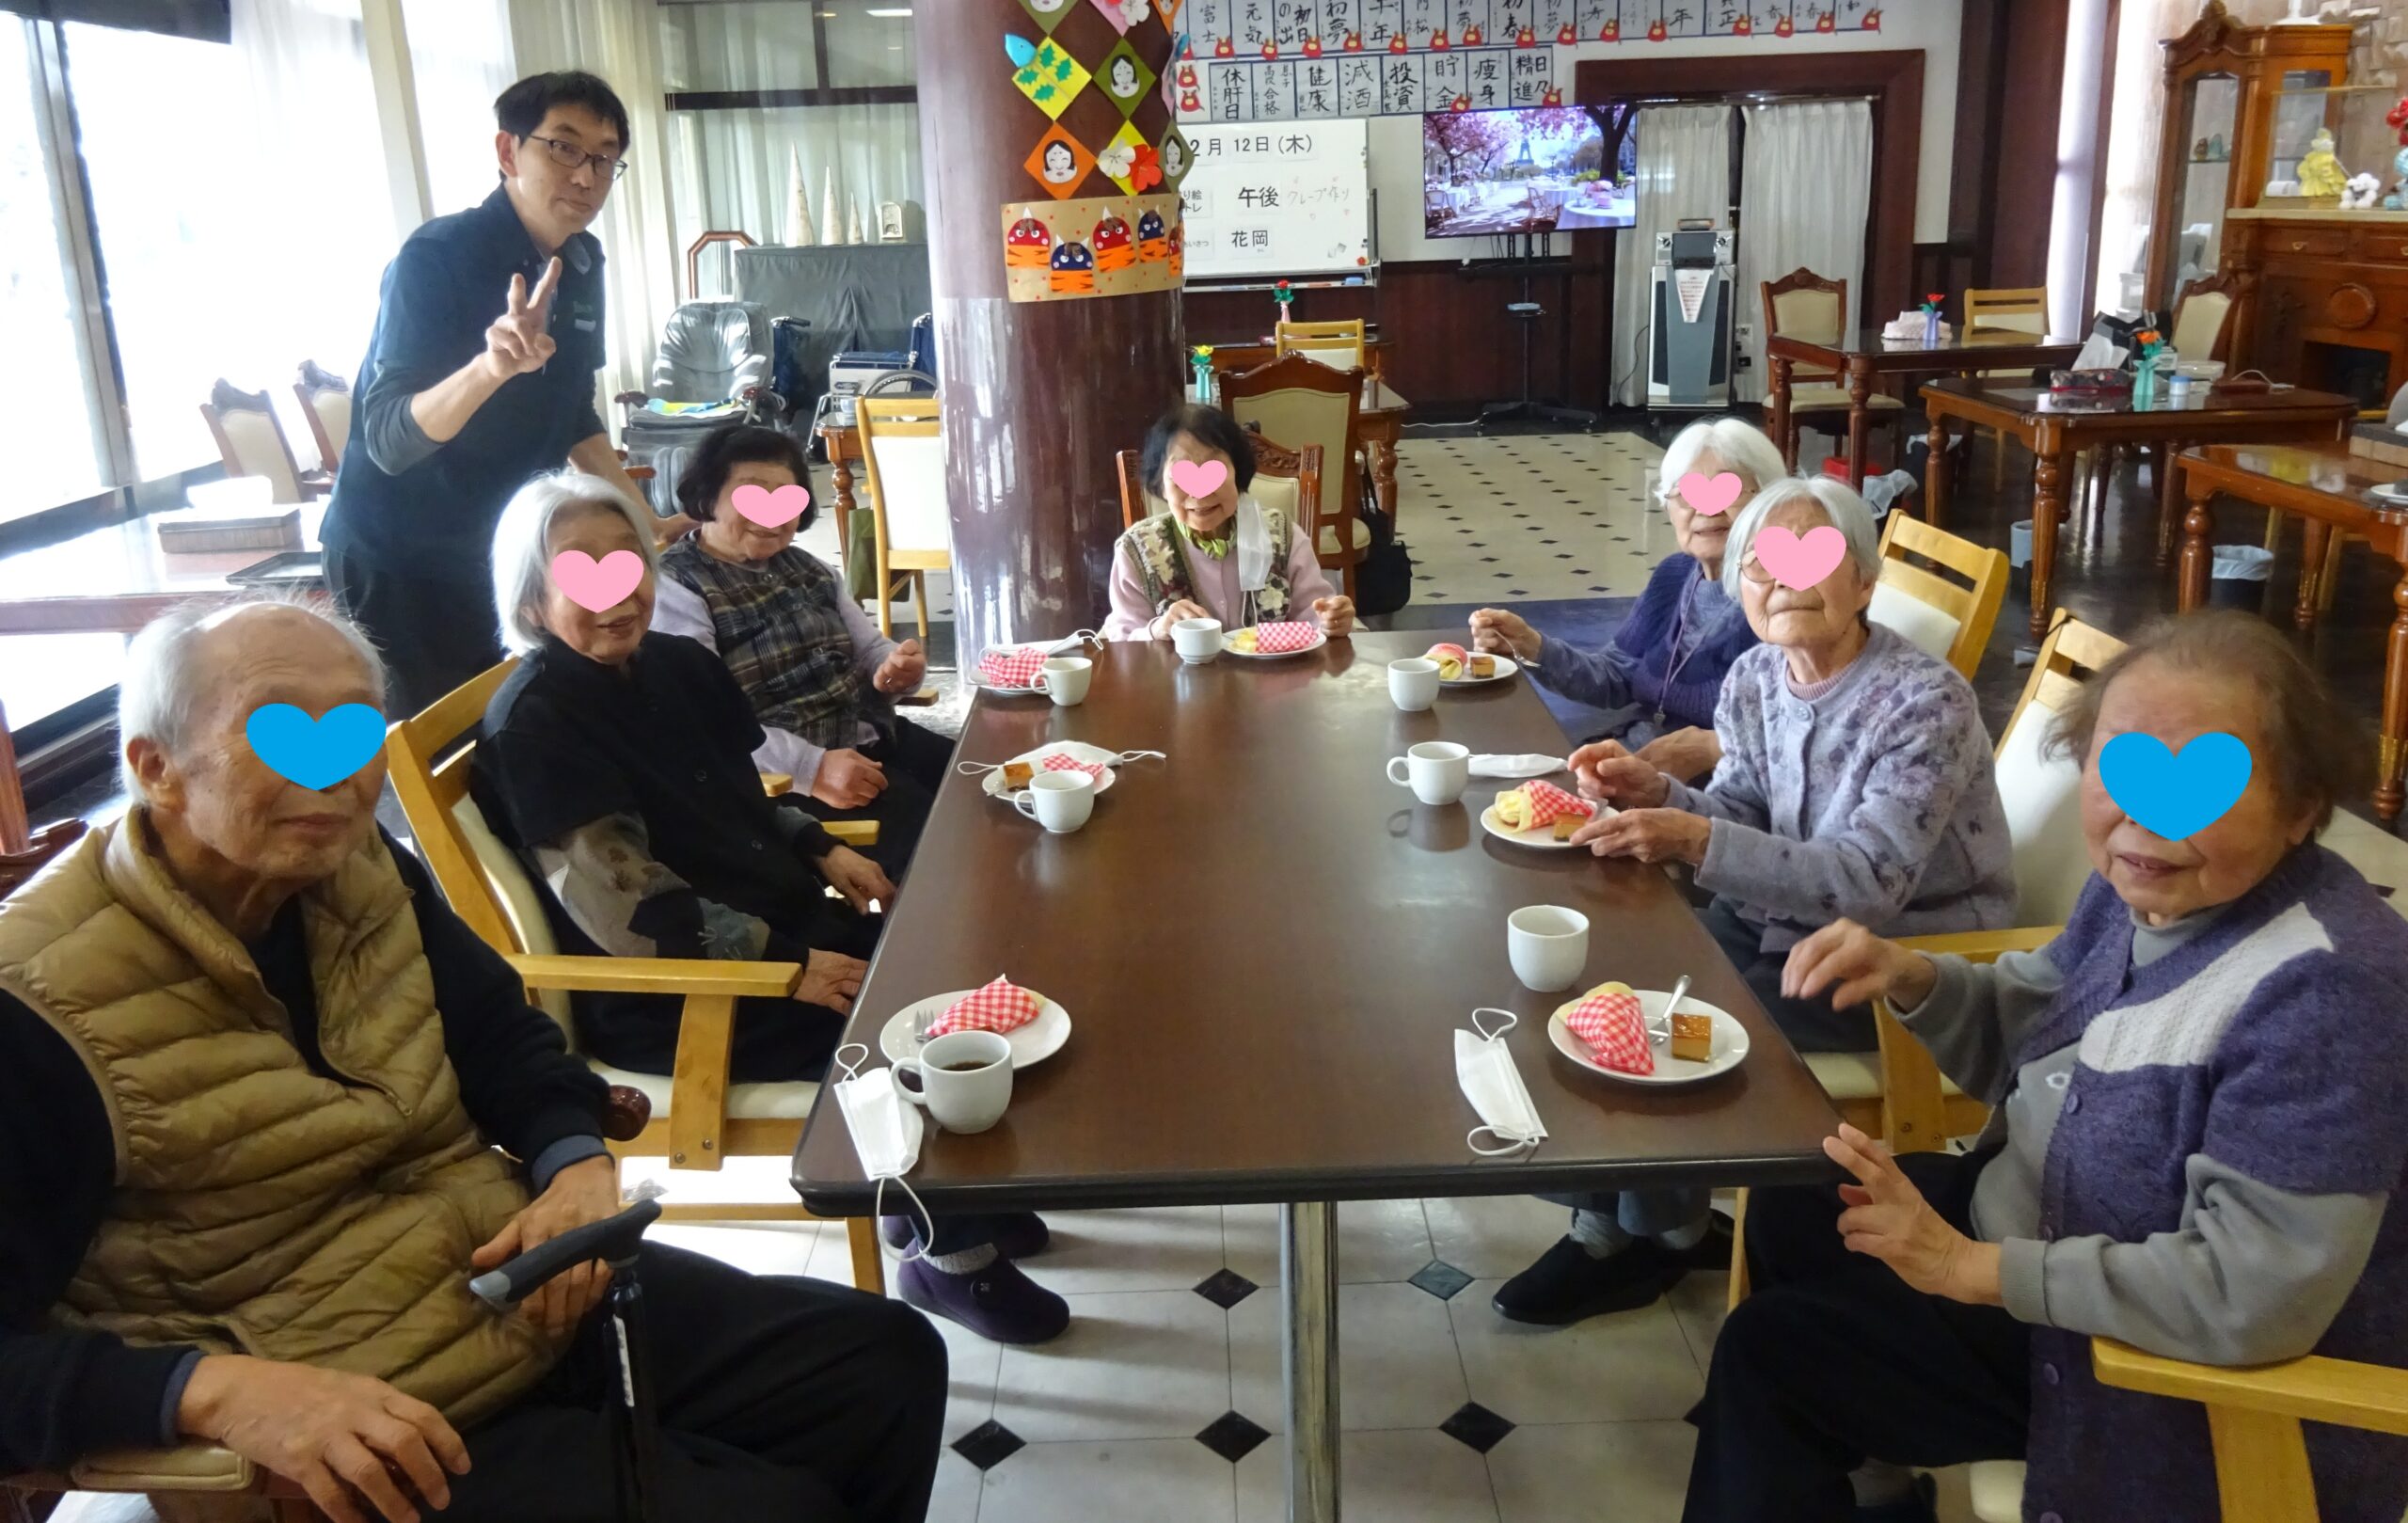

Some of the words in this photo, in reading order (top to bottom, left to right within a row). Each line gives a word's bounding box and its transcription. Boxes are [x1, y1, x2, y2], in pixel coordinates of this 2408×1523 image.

[1244, 3, 1263, 45] 元気
[1222, 68, 1246, 119] 休肝日
[1308, 65, 1333, 112] 健康
[1389, 61, 1418, 111] 投資
[1238, 186, 1279, 208] 午後
[1231, 230, 1269, 247] 花岡
